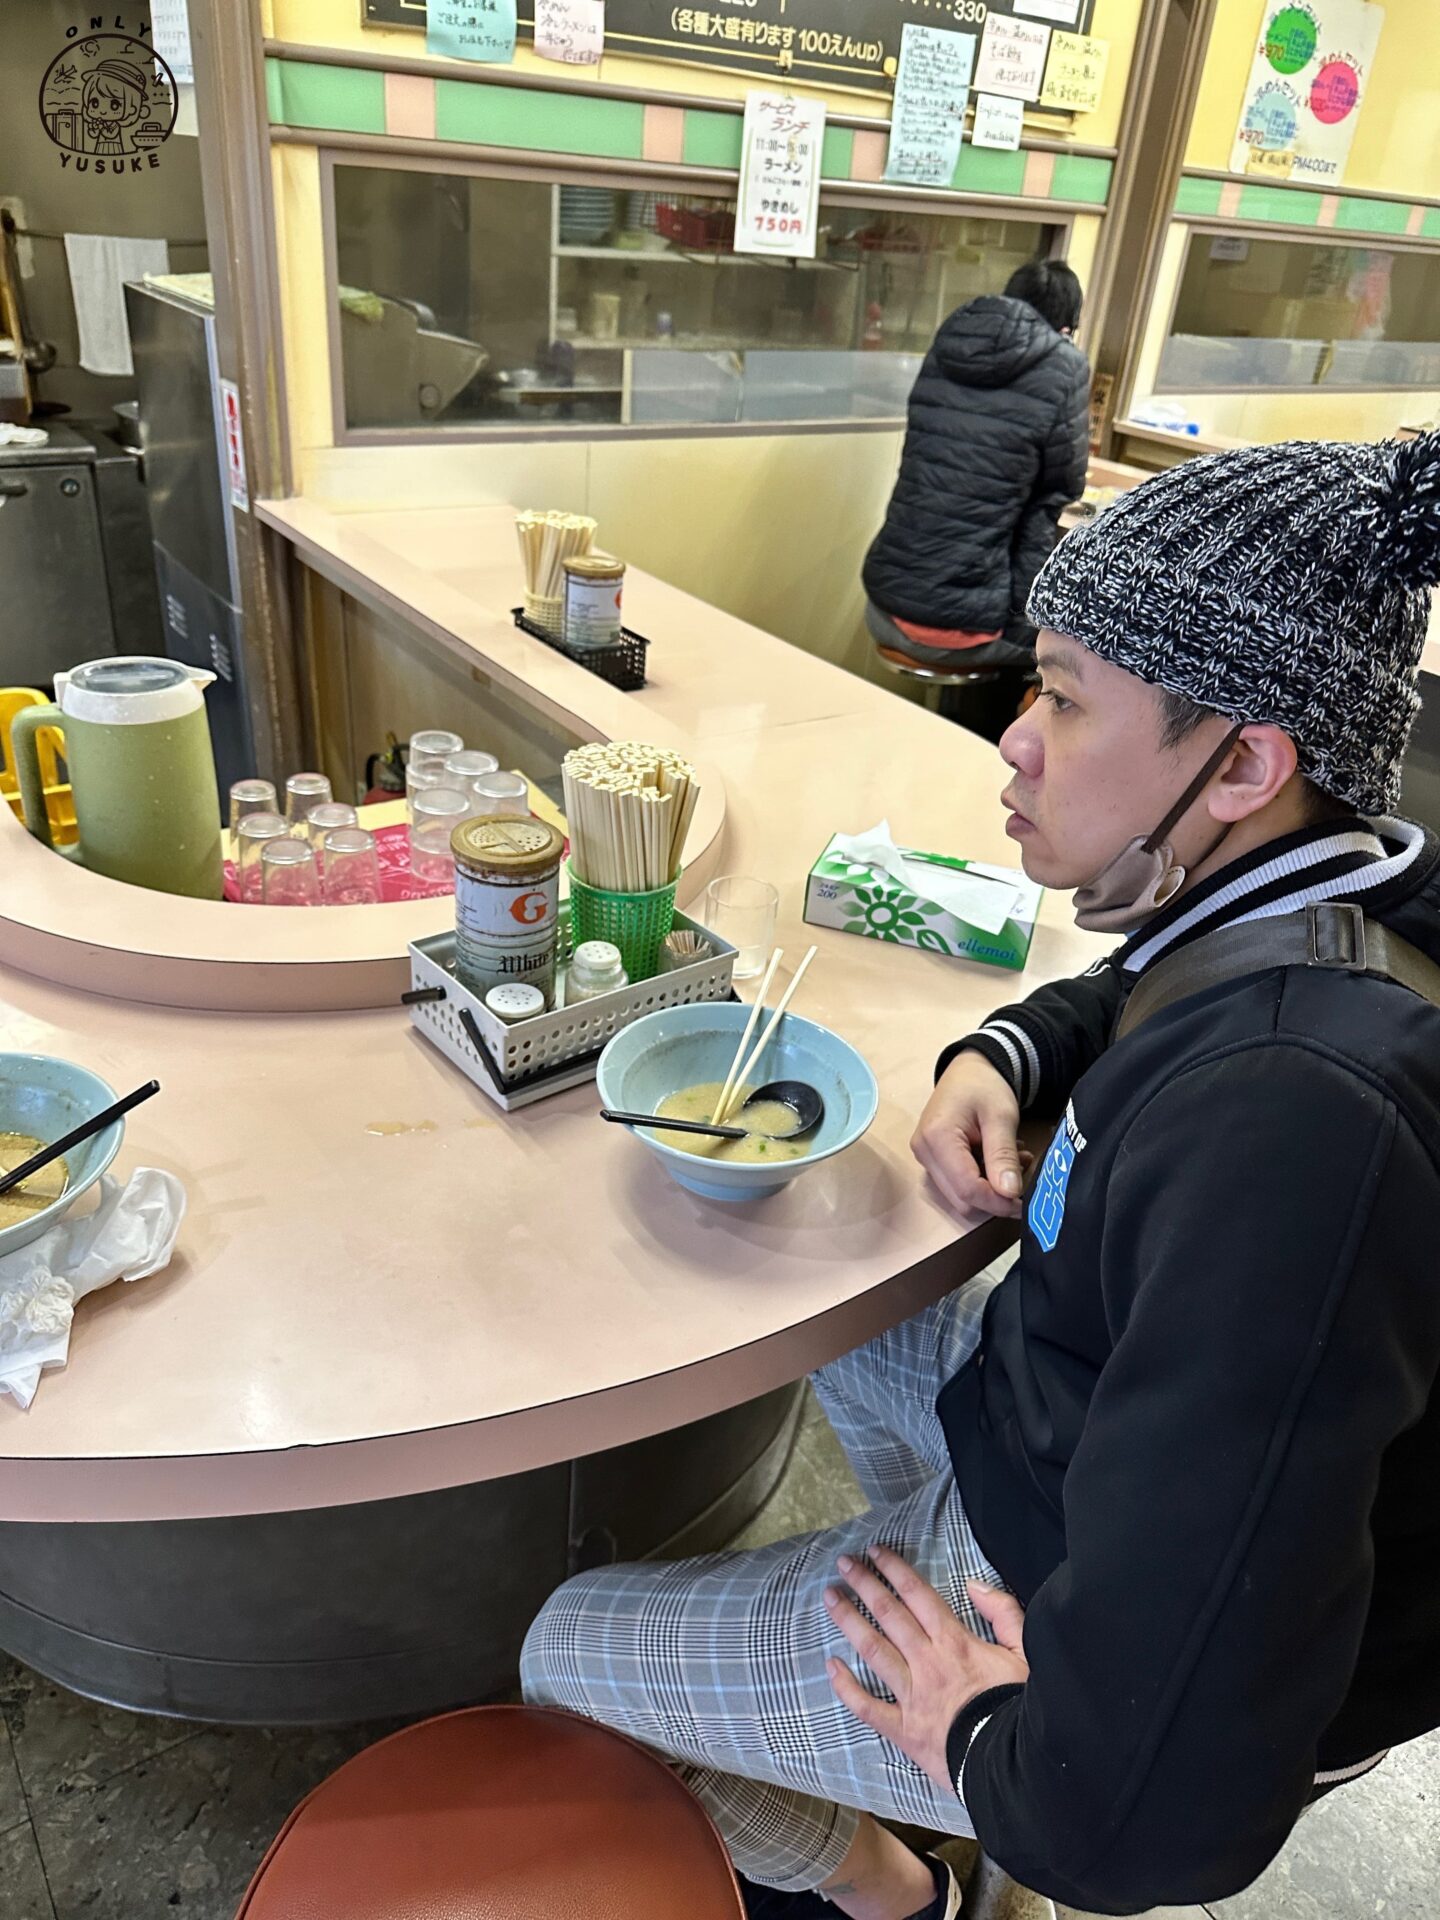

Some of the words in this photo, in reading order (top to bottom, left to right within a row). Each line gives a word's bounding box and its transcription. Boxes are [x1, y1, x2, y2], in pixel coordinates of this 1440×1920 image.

[759, 101, 796, 115] サービス
[771, 117, 811, 135] ランチ
[764, 158, 802, 174] ラーメン
[761, 199, 799, 215] やきめし
[754, 216, 802, 235] 750円
[817, 888, 838, 901] 200
[508, 890, 550, 926] G
[957, 937, 1018, 962] ellemoi
[496, 952, 550, 975] White
